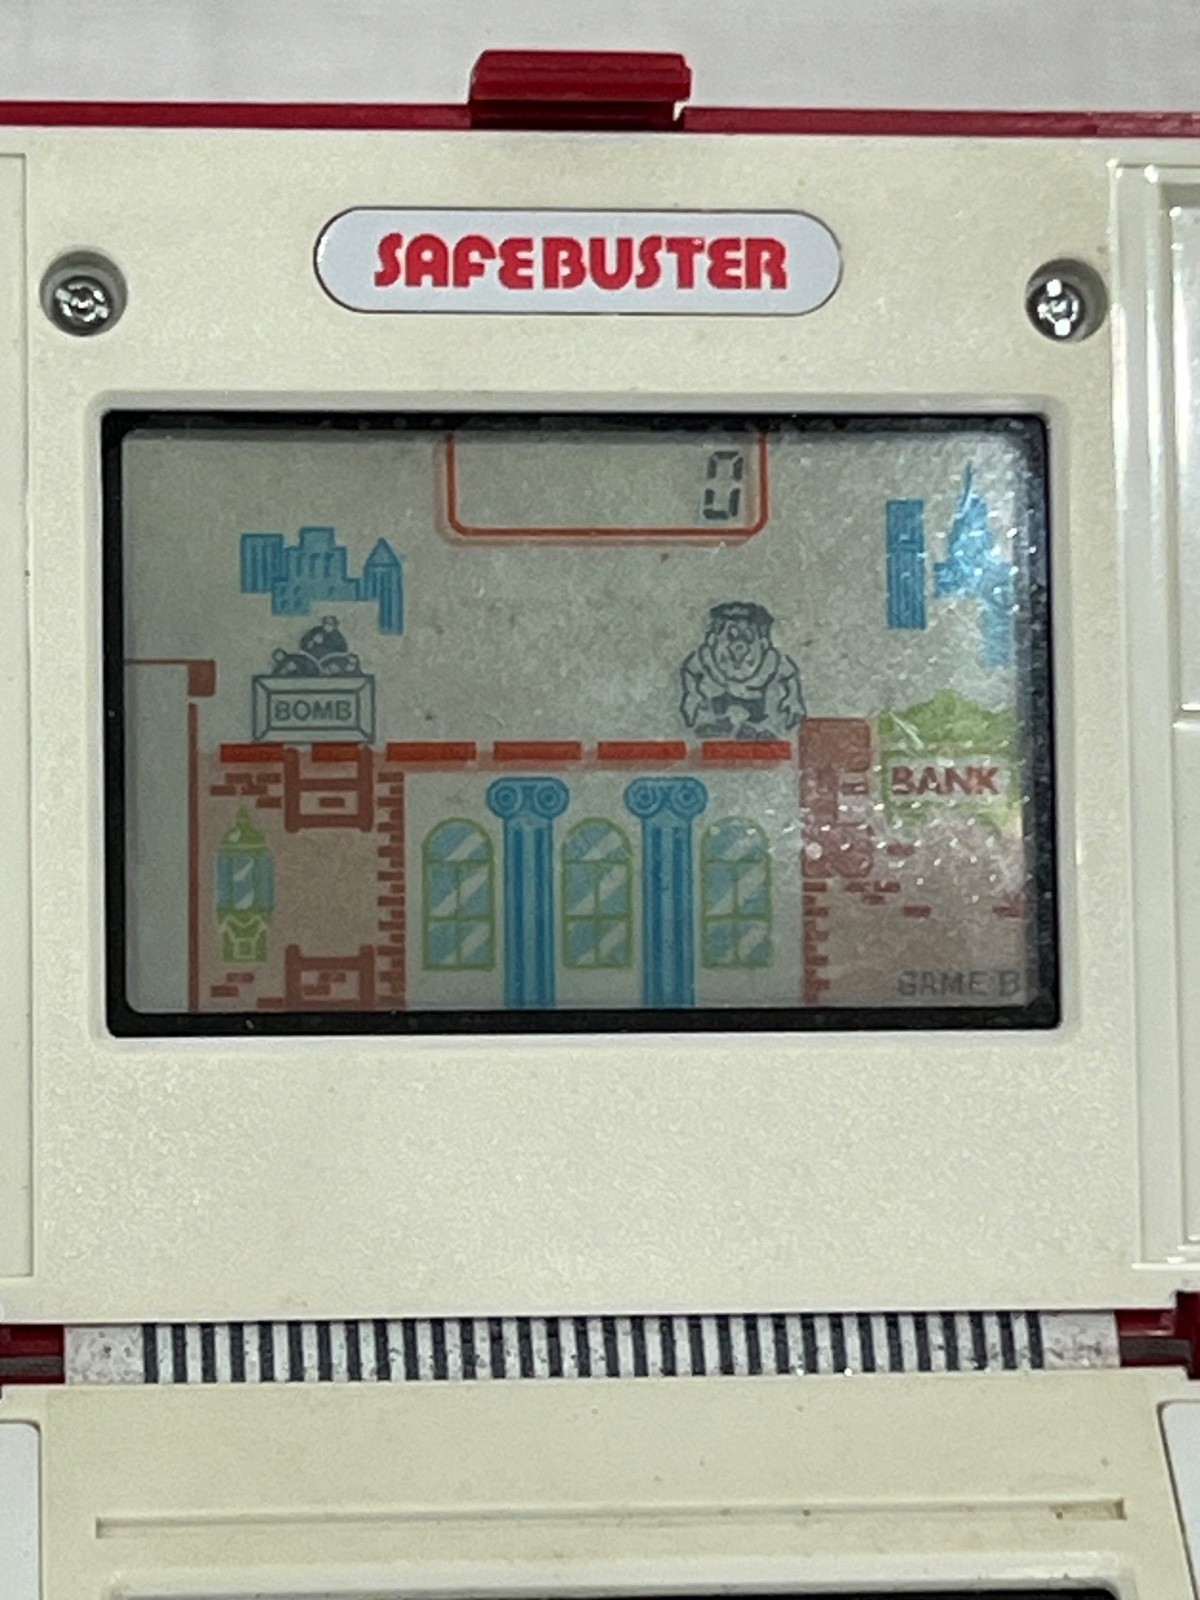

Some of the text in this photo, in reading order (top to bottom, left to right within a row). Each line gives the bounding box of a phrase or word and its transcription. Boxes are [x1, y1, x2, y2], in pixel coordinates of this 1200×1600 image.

[374, 232, 788, 290] SAFEBUSTER
[702, 451, 744, 521] 0
[274, 700, 353, 722] BOMB
[891, 766, 1000, 795] BANK
[898, 970, 1020, 997] GAME B
